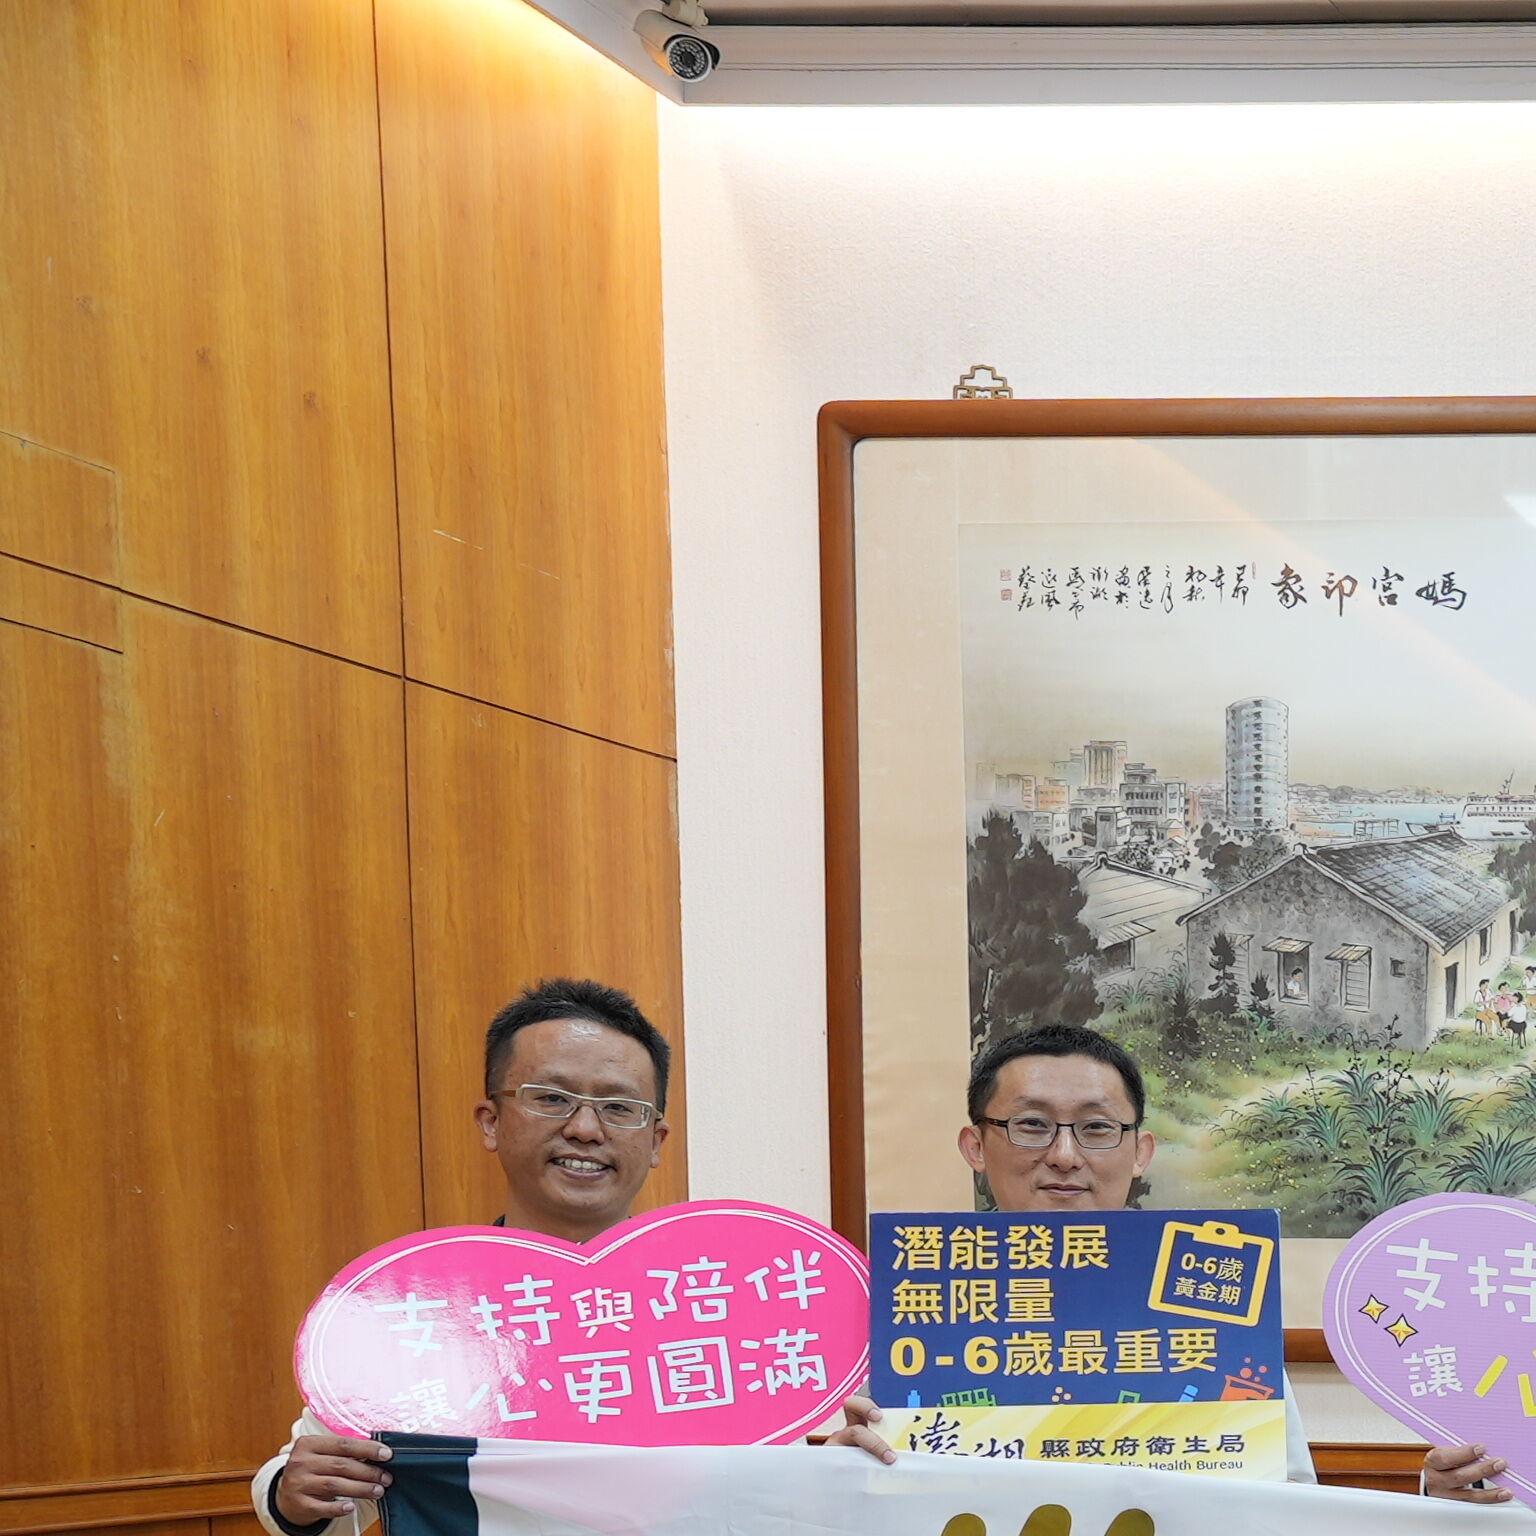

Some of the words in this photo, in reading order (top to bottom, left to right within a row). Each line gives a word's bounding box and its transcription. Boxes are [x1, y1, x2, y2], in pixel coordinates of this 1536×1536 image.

[891, 1225, 1110, 1270] 潛能發展
[1180, 1252, 1244, 1284] 0-6歲
[374, 1249, 826, 1356] 支持與陪伴
[891, 1279, 1055, 1325] 無限量
[1173, 1277, 1241, 1306] 黃金期
[1197, 1460, 1243, 1471] Bureau
